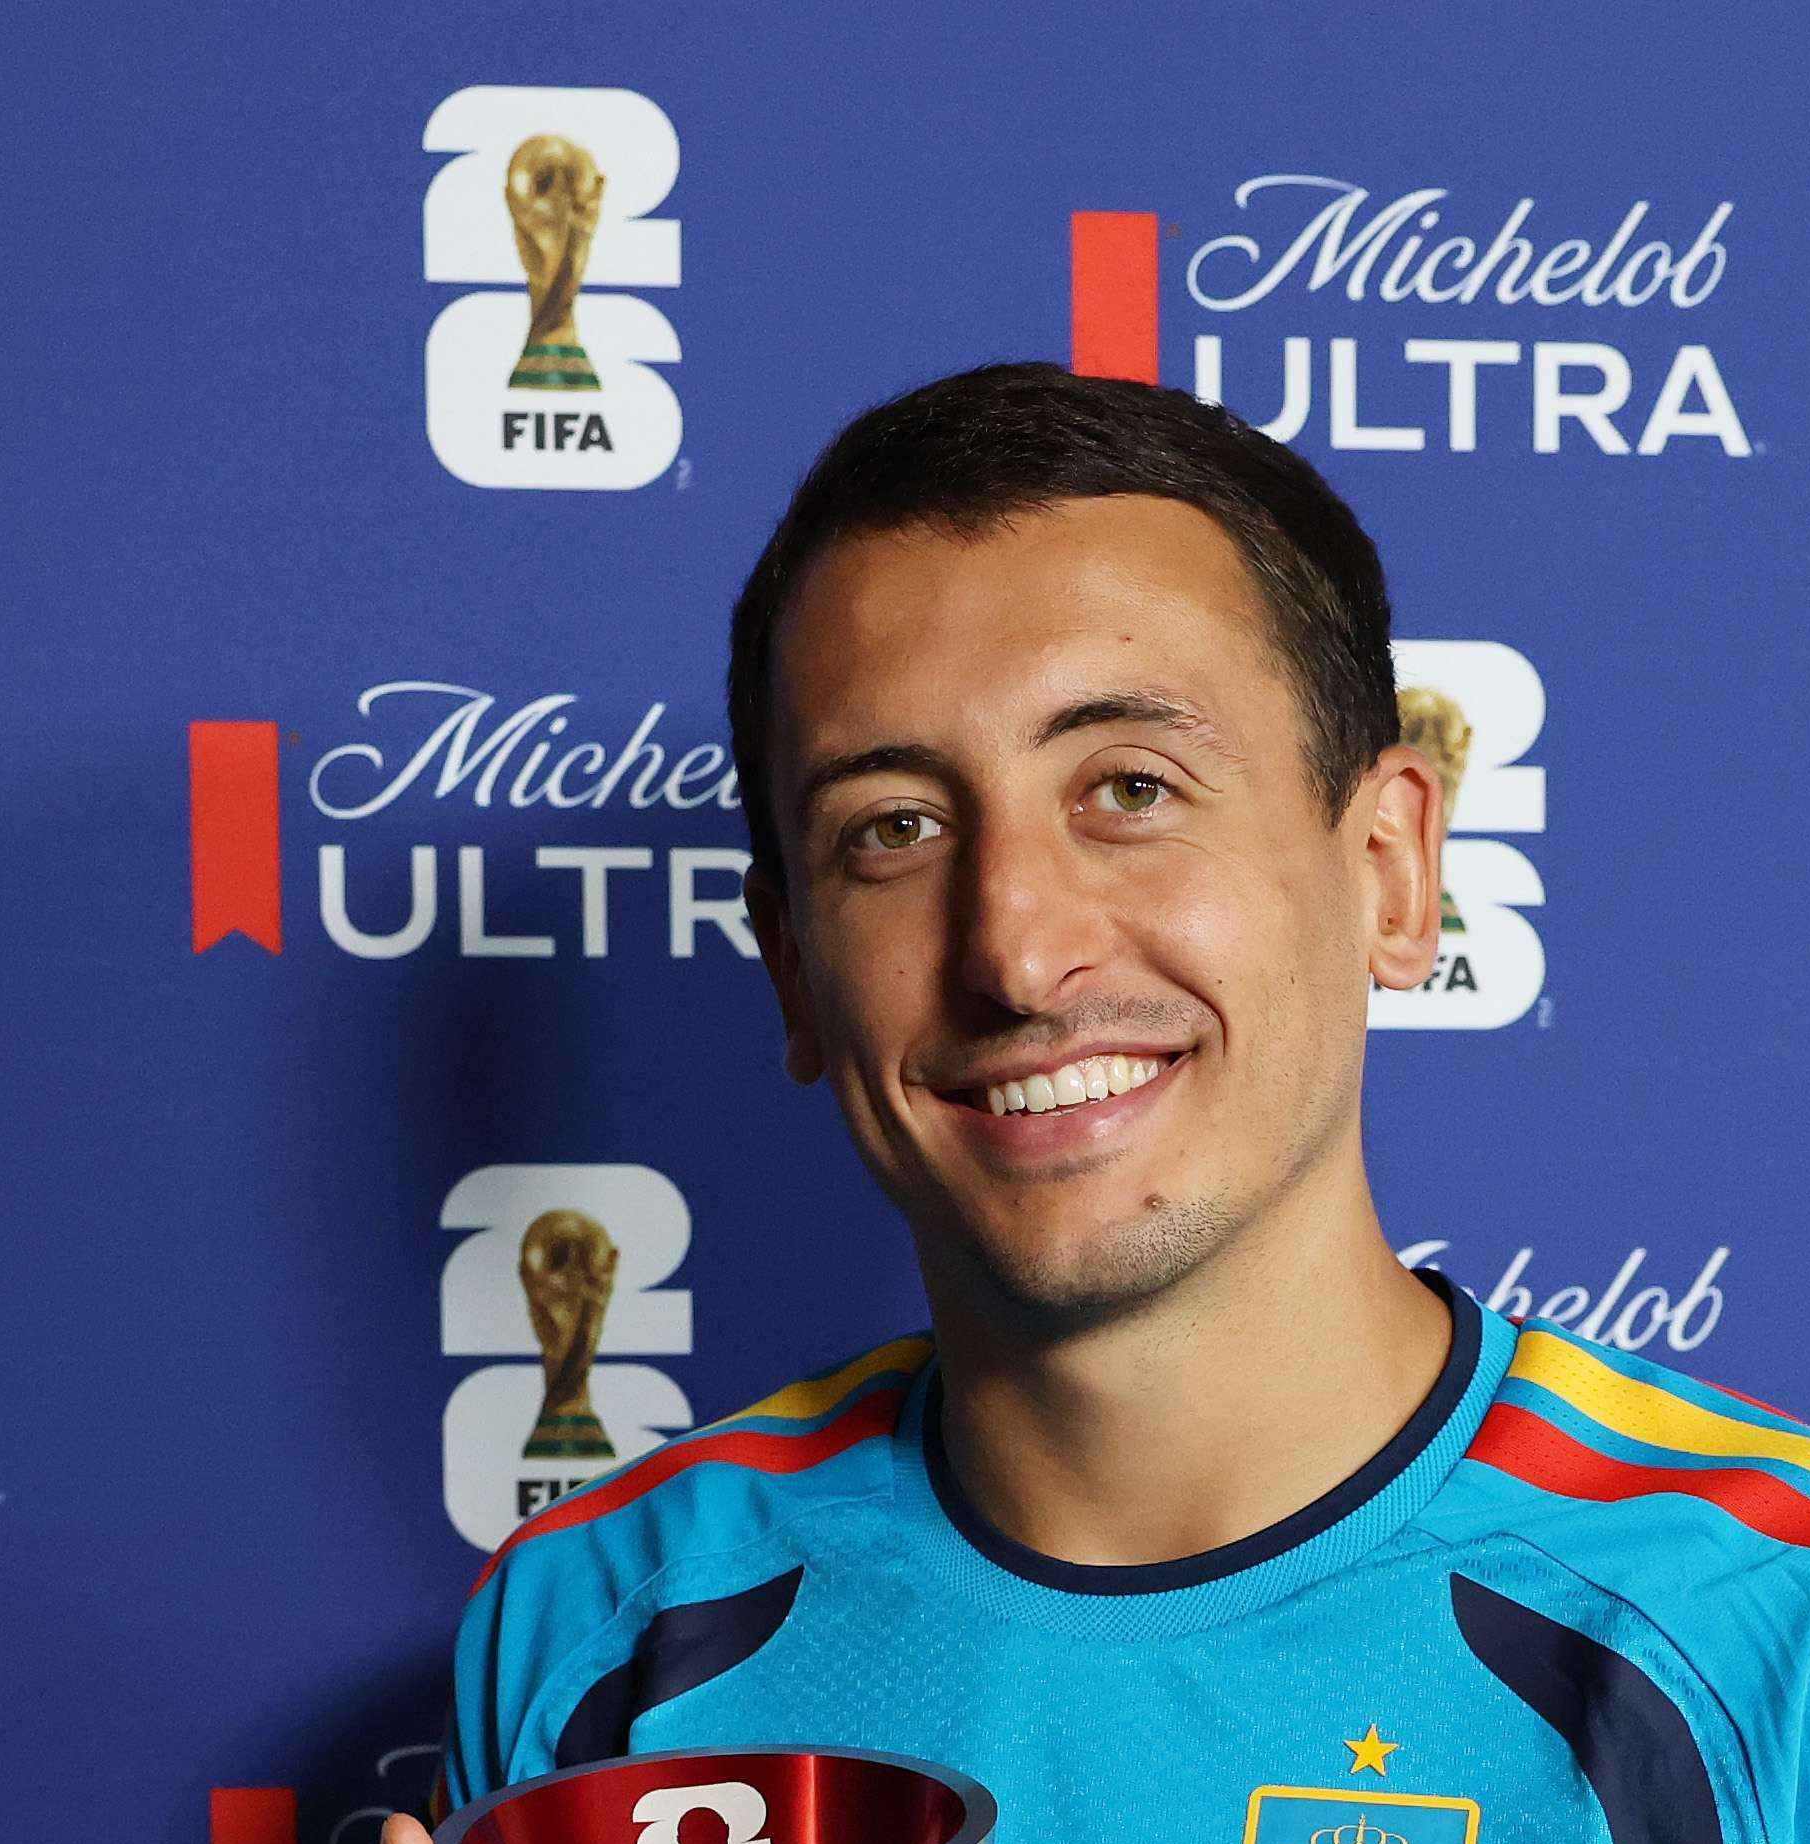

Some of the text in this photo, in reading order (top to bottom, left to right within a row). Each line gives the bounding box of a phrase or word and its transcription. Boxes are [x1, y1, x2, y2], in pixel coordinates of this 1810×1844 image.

[1188, 176, 1732, 310] Michelob
[503, 413, 612, 451] FIFA
[1193, 334, 1751, 456] ULTRA
[310, 682, 742, 819] Miche
[320, 846, 759, 957] ULTR
